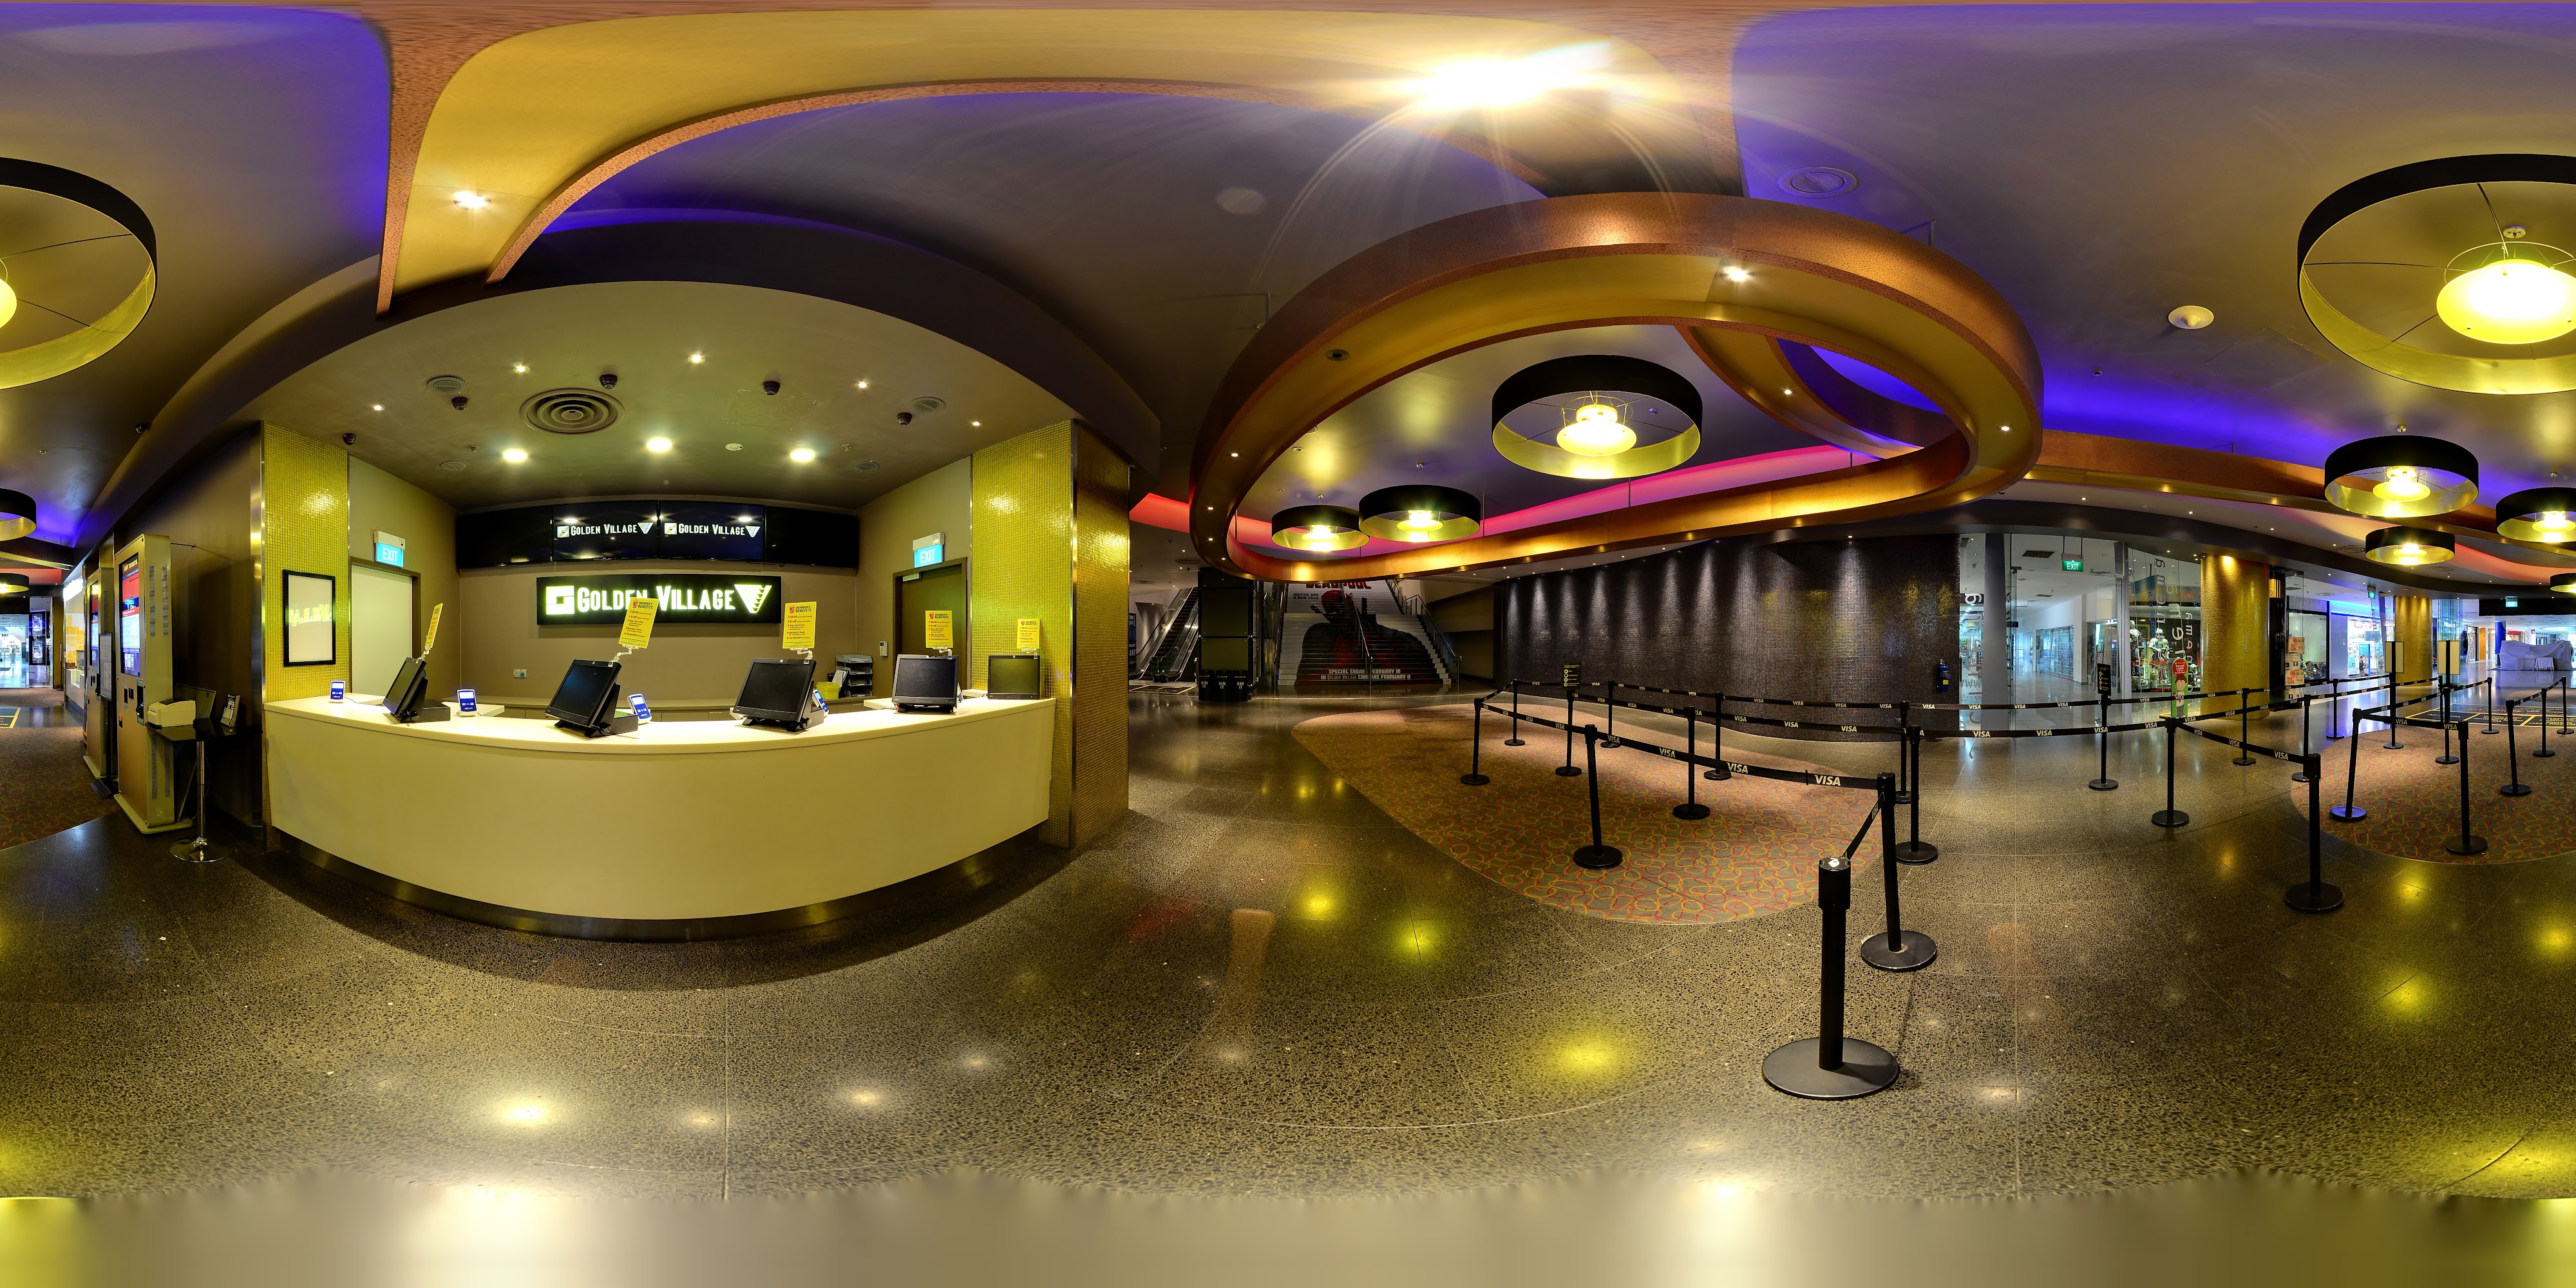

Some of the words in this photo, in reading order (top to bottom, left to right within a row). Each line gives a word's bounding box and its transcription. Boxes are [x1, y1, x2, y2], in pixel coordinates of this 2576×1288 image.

[571, 526, 600, 536] GOLDEN
[603, 524, 638, 534] VILLAGE
[678, 523, 709, 534] GOLDEN
[712, 524, 745, 536] VILLAGE
[383, 547, 398, 562] EXIT
[920, 548, 936, 564] EXIT
[2067, 562, 2079, 571] EXIT
[656, 585, 737, 611] VILLAGE
[1555, 722, 1565, 730] VISA
[2193, 727, 2203, 737] VISA
[1607, 734, 1620, 744] VISA
[2228, 739, 2240, 748] VISA
[1659, 747, 1676, 759] VISA
[2274, 750, 2289, 761] VISA
[1727, 762, 1748, 774] VISA
[1815, 774, 1841, 786] VISA
